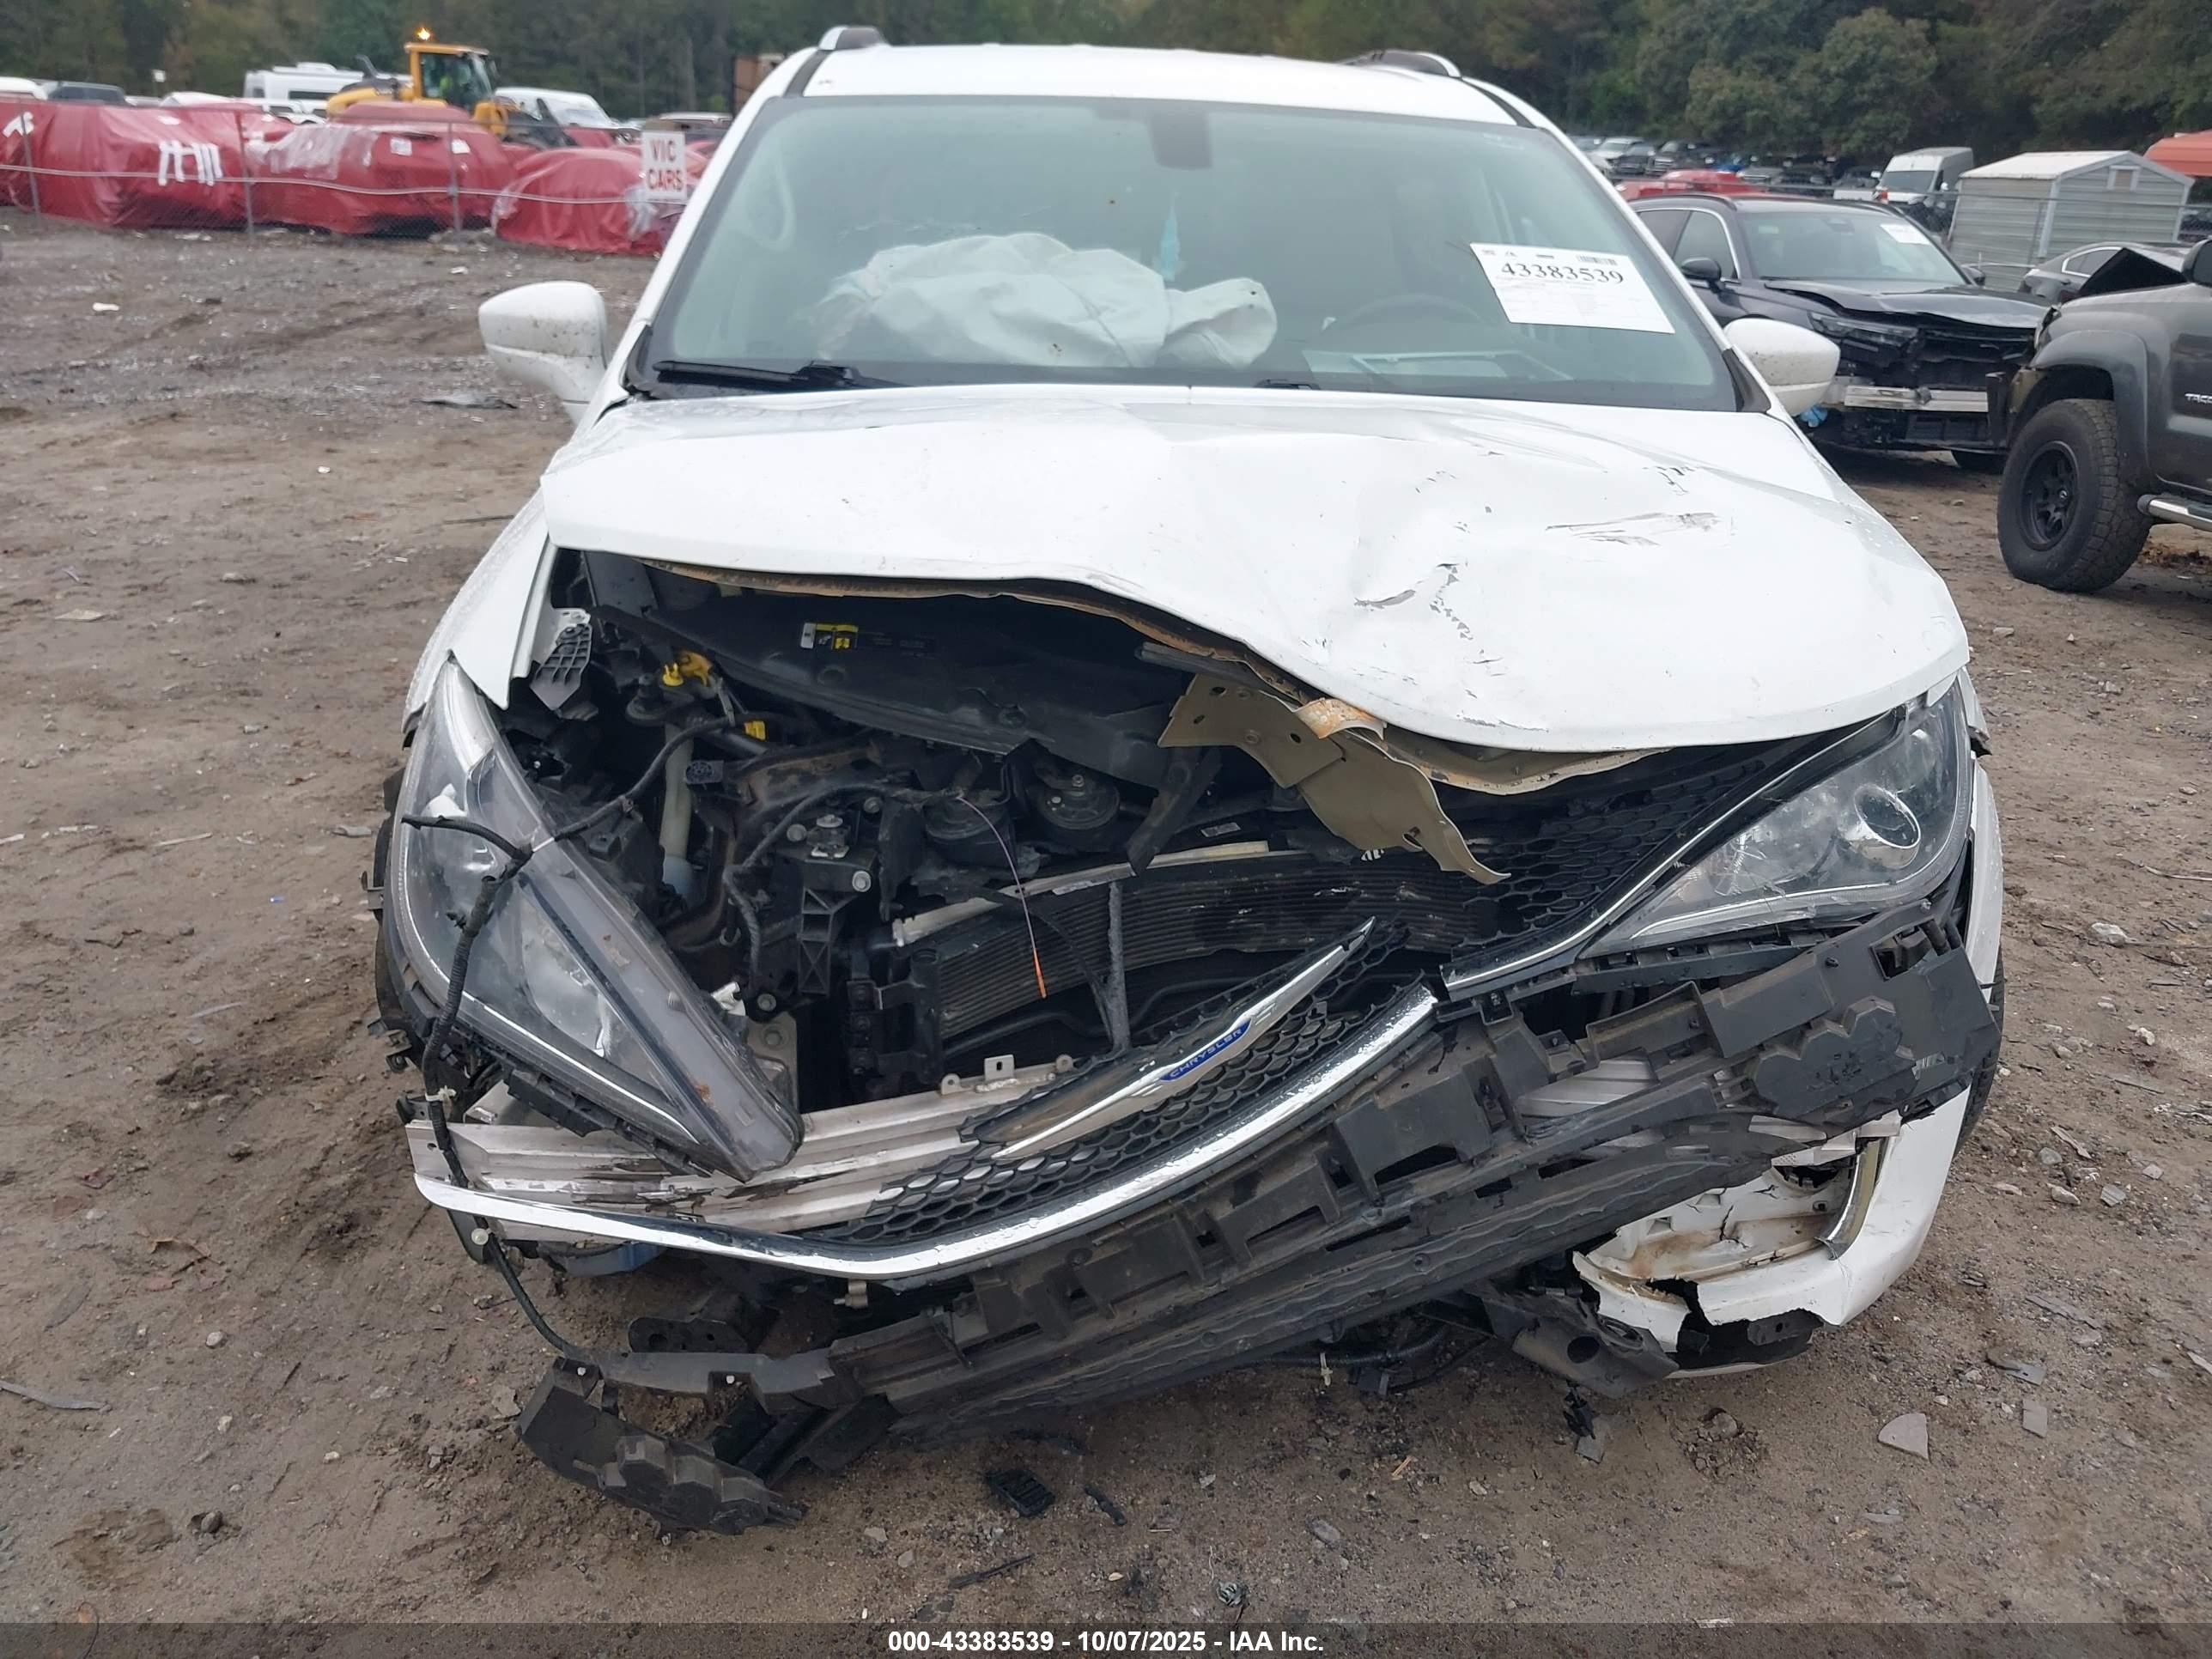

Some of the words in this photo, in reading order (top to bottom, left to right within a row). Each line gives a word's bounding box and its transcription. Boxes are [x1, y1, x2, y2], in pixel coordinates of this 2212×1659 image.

[649, 140, 677, 162] VIC
[647, 168, 683, 191] CARS
[1501, 261, 1625, 284] 43383539
[1170, 1028, 1243, 1078] CHRYSLER
